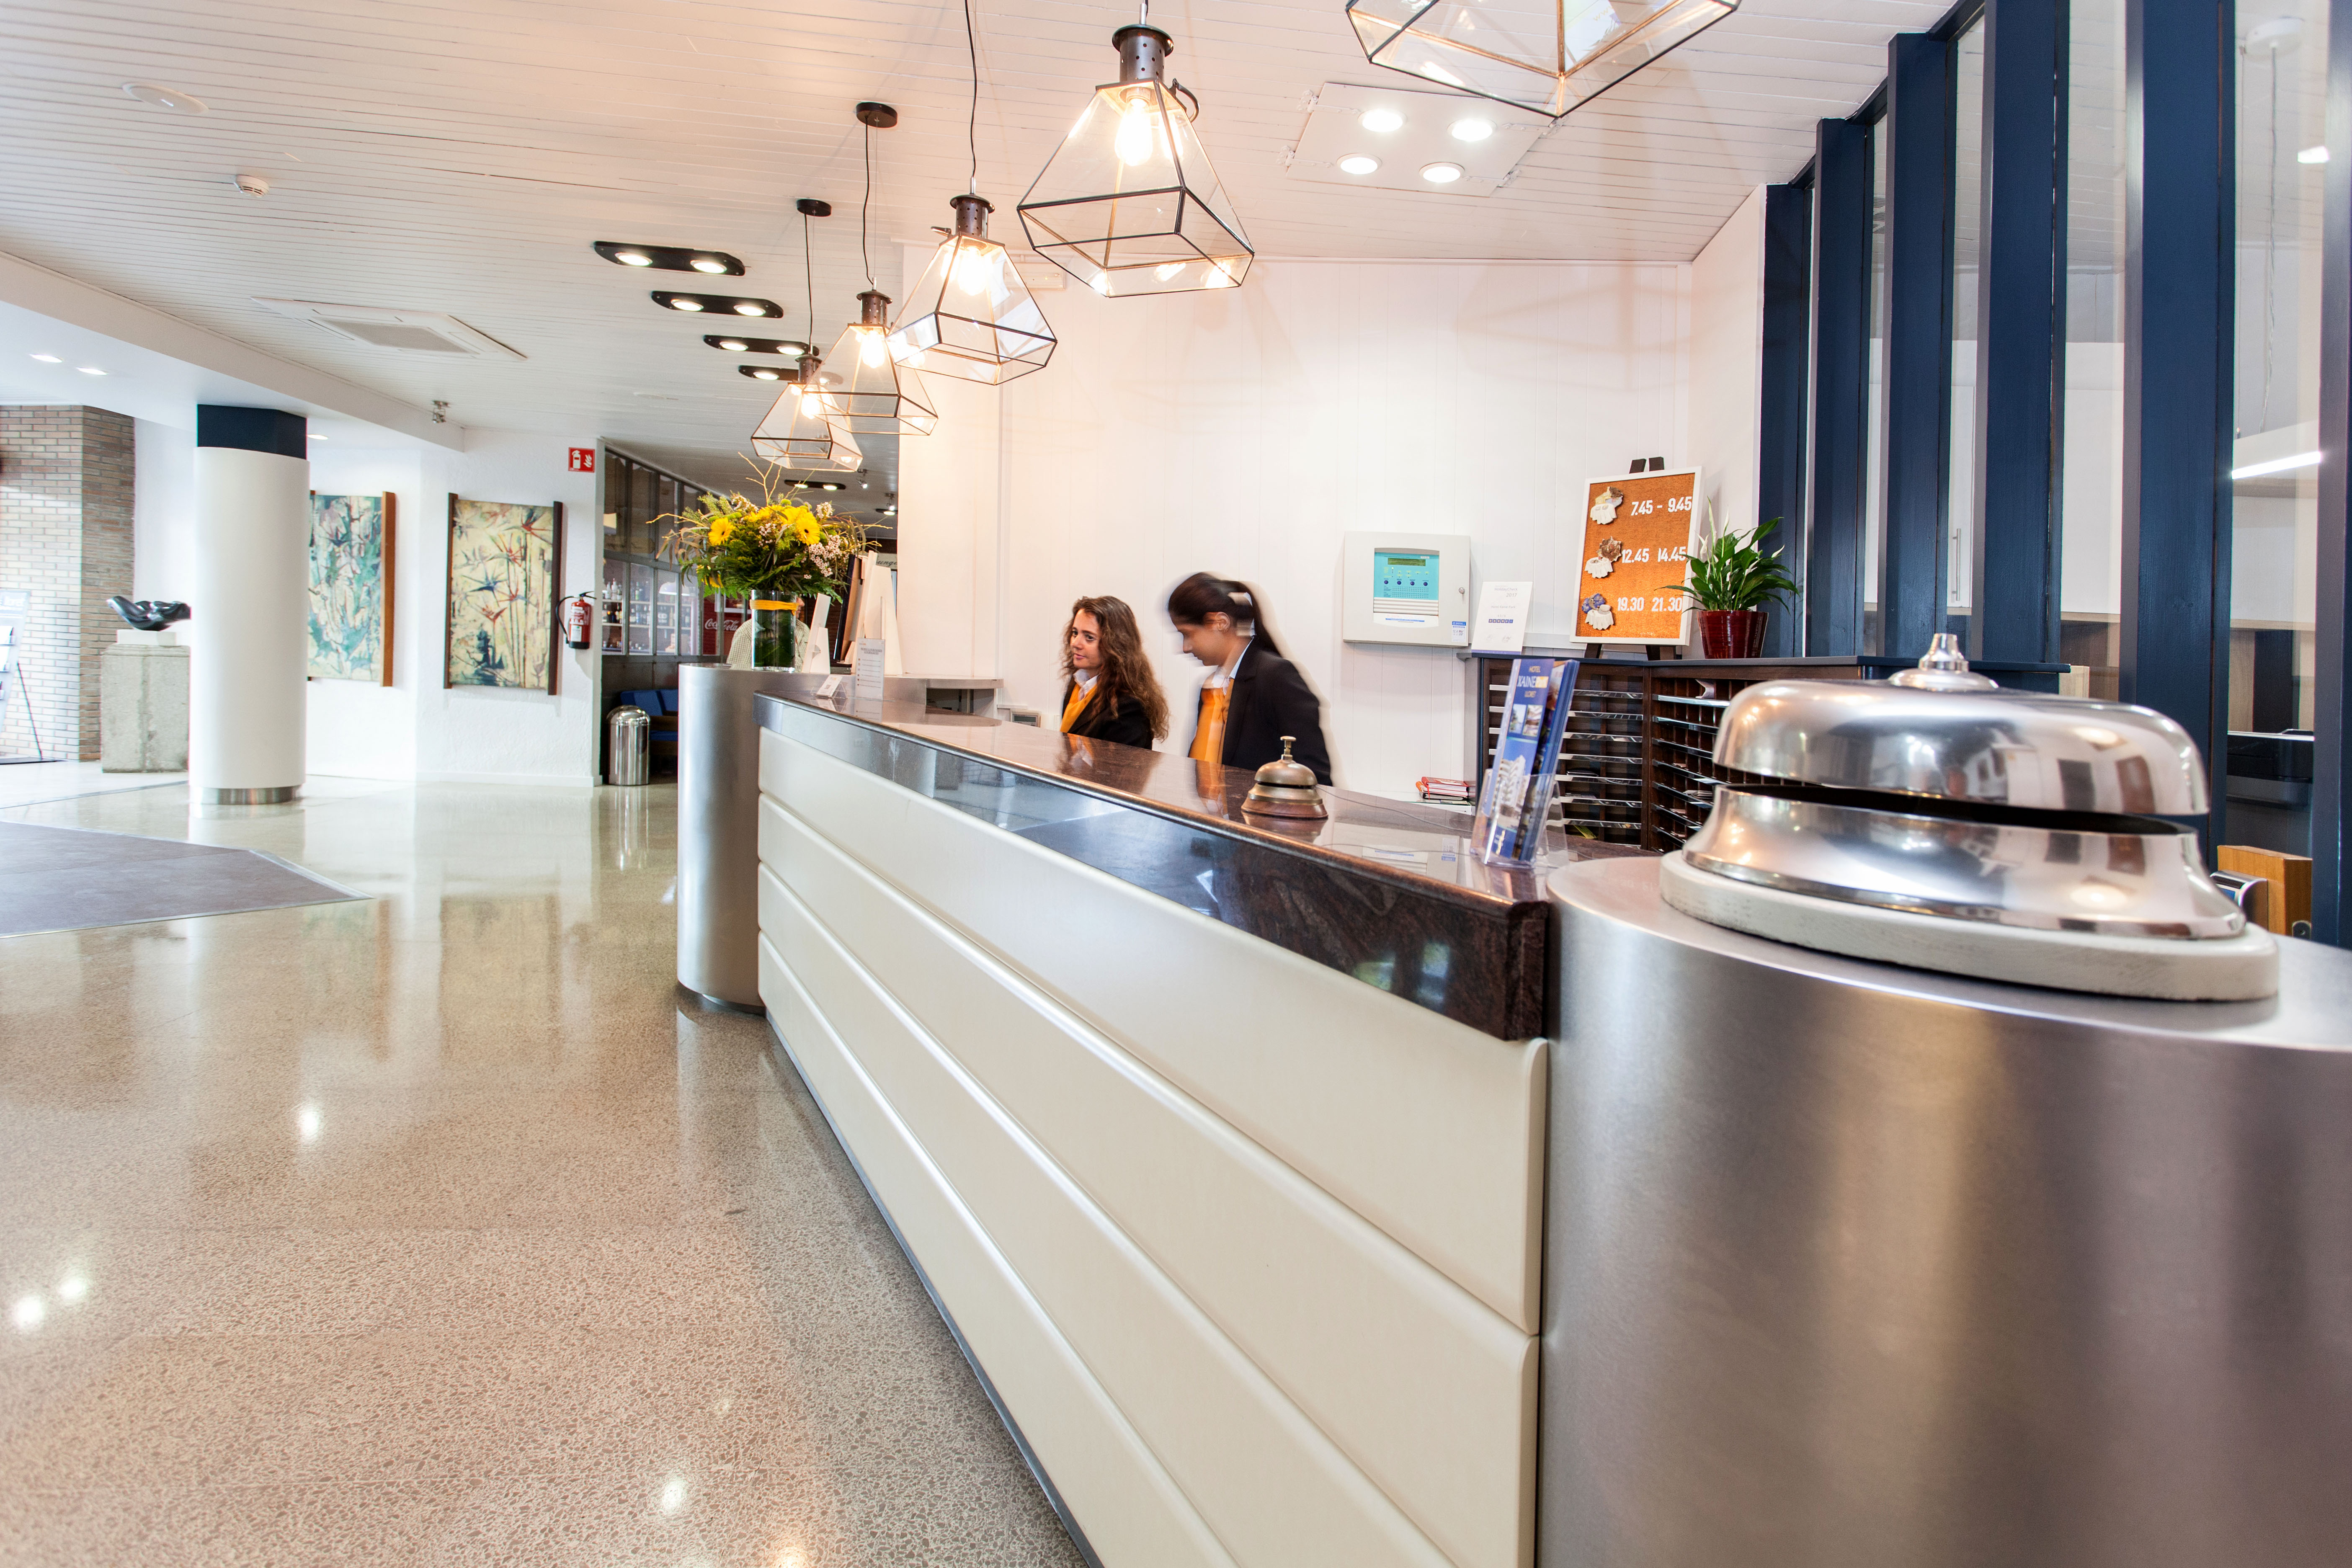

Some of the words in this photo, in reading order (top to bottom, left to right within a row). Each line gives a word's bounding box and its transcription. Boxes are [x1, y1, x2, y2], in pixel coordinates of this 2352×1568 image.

[1631, 500, 1653, 516] 7.45
[1668, 496, 1692, 513] 9.45
[1622, 548, 1649, 563] 12.45
[1657, 546, 1686, 562] 14.45
[1617, 597, 1644, 611] 19.30
[1651, 597, 1682, 611] 21.30
